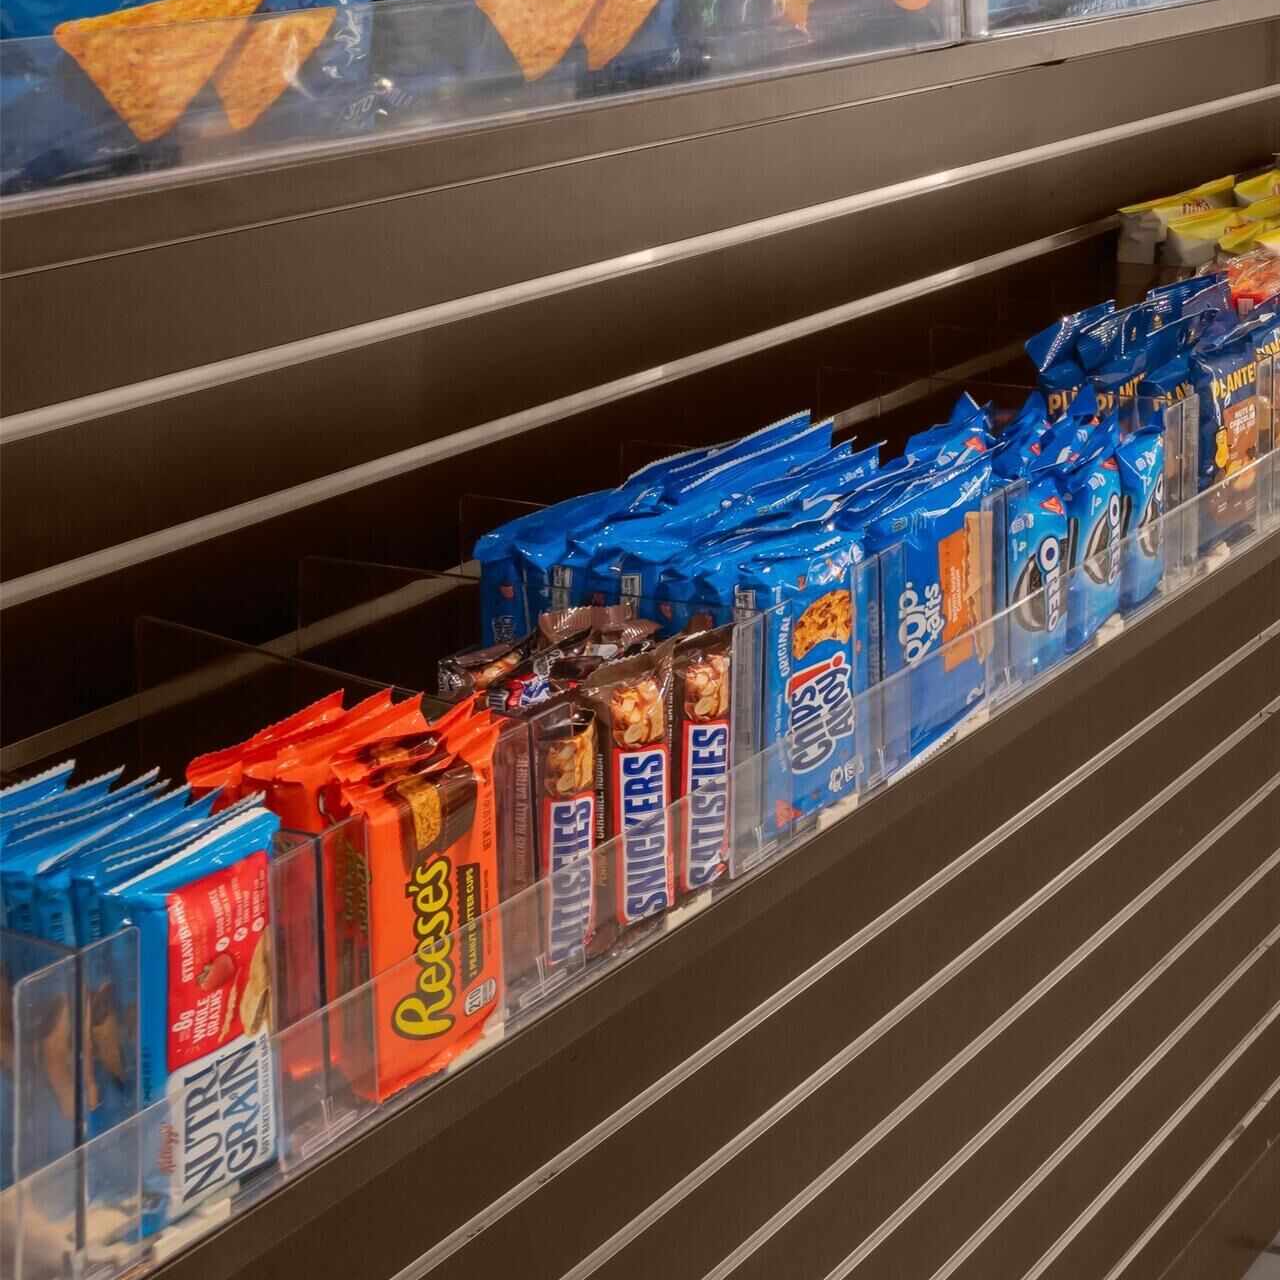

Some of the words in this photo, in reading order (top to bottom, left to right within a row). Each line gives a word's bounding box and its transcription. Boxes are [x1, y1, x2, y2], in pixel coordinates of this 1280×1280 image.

[1107, 493, 1122, 585] OREO
[1038, 536, 1061, 632] OREO
[777, 617, 791, 676] ORIGINAL
[790, 686, 833, 772] Chips
[515, 801, 528, 834] REALLY
[623, 752, 668, 921] SNICKERS
[690, 727, 727, 886] SATISFIES
[466, 868, 475, 893] CUPS
[467, 894, 476, 931] BUTTER
[173, 898, 195, 982] STRAWBERRY
[395, 858, 452, 1037] Reese's
[468, 933, 477, 970] PEANUT
[172, 1010, 195, 1033] 8g
[193, 997, 209, 1043] WHOLE
[206, 989, 222, 1037] GRAINS
[468, 988, 481, 1011] 210
[182, 1062, 226, 1204] NUTRI
[216, 1040, 260, 1173] GRAIN
